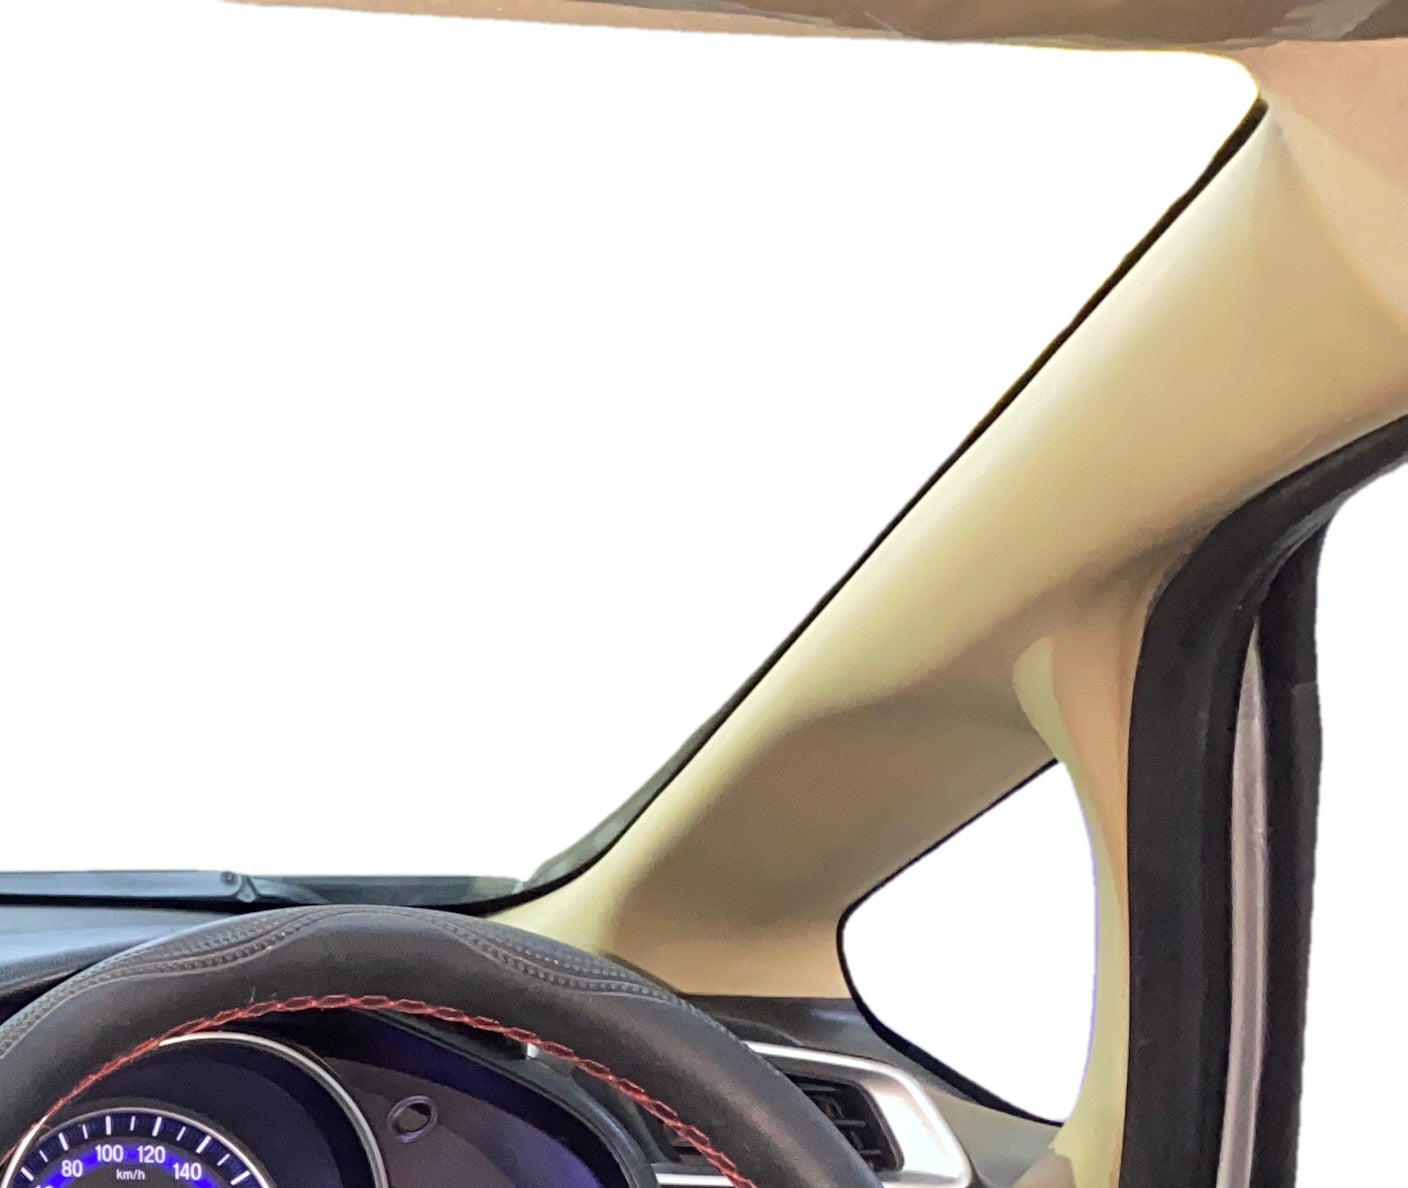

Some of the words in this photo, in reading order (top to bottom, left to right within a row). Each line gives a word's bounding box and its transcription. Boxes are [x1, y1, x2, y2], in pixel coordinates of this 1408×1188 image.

[95, 1144, 124, 1163] 100
[137, 1146, 166, 1164] 120
[61, 1160, 83, 1178] 80
[116, 1168, 146, 1181] km/h
[173, 1163, 202, 1181] 140
